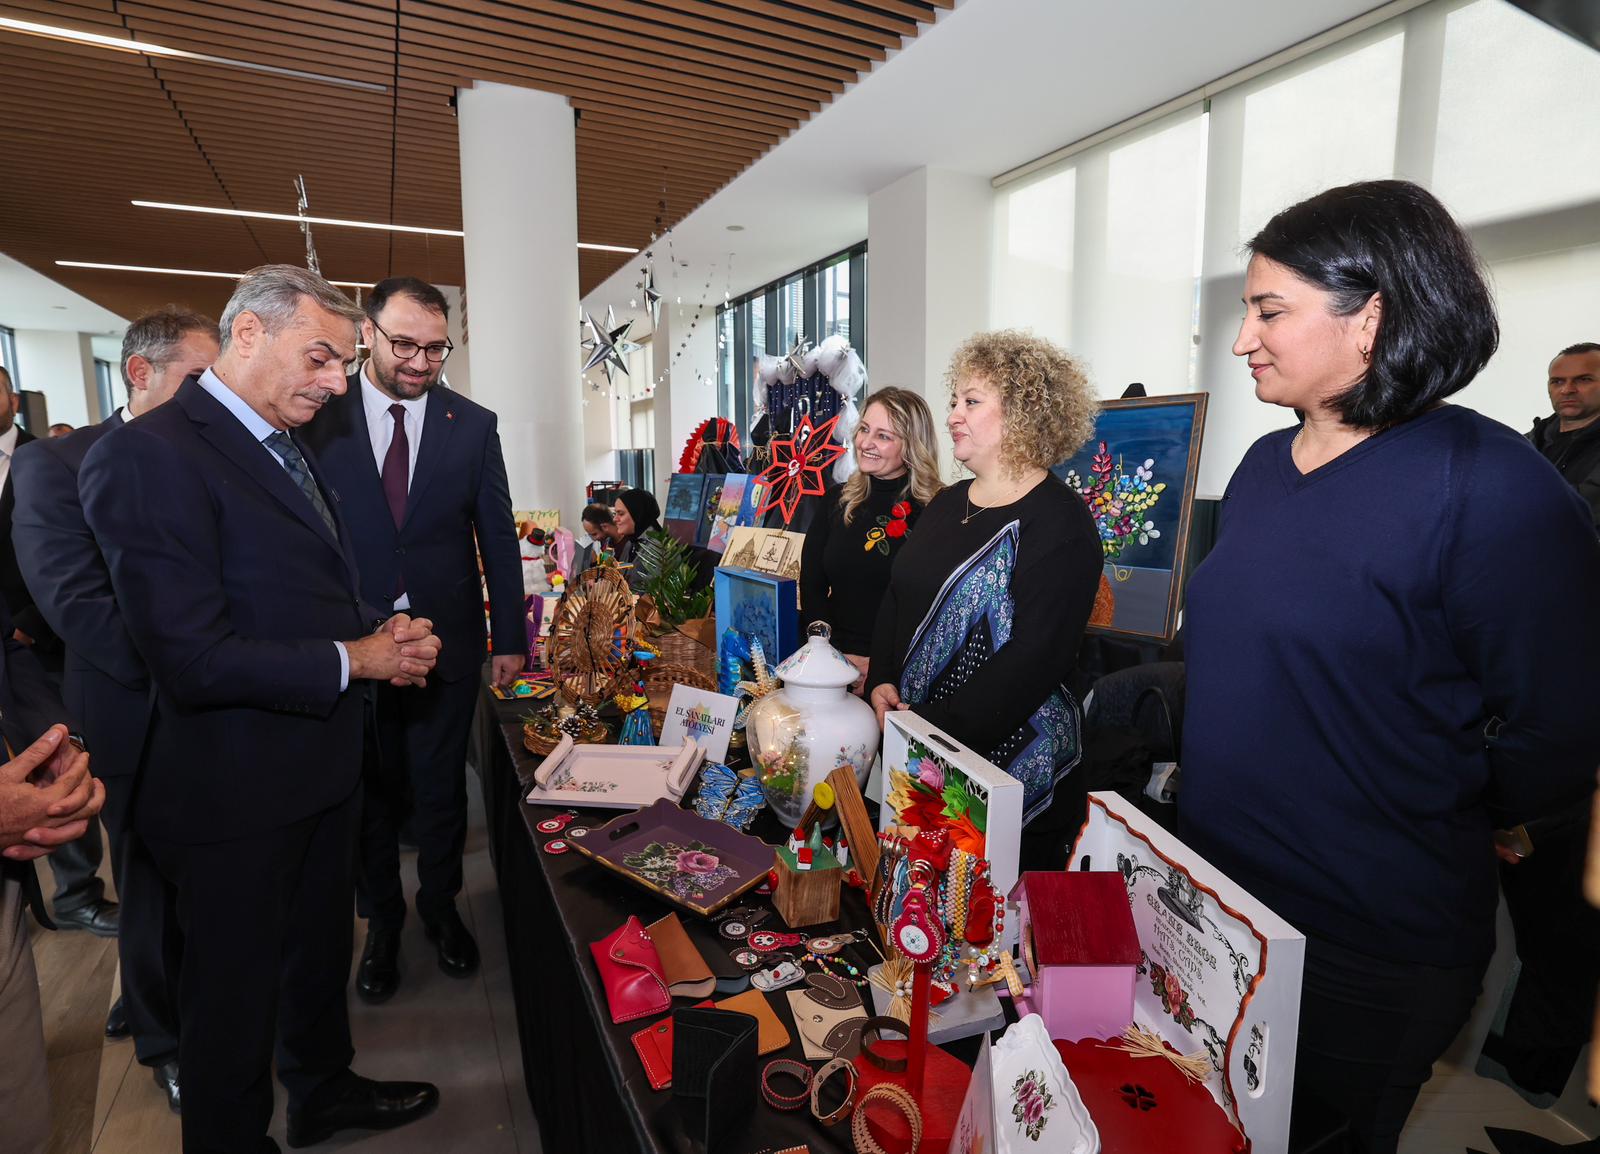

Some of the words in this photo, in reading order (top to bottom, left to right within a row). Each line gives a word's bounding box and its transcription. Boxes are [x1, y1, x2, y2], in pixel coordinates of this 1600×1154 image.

[675, 706, 684, 717] EL
[686, 709, 726, 727] SANATLARI
[680, 718, 716, 735] ATÖLYESİ
